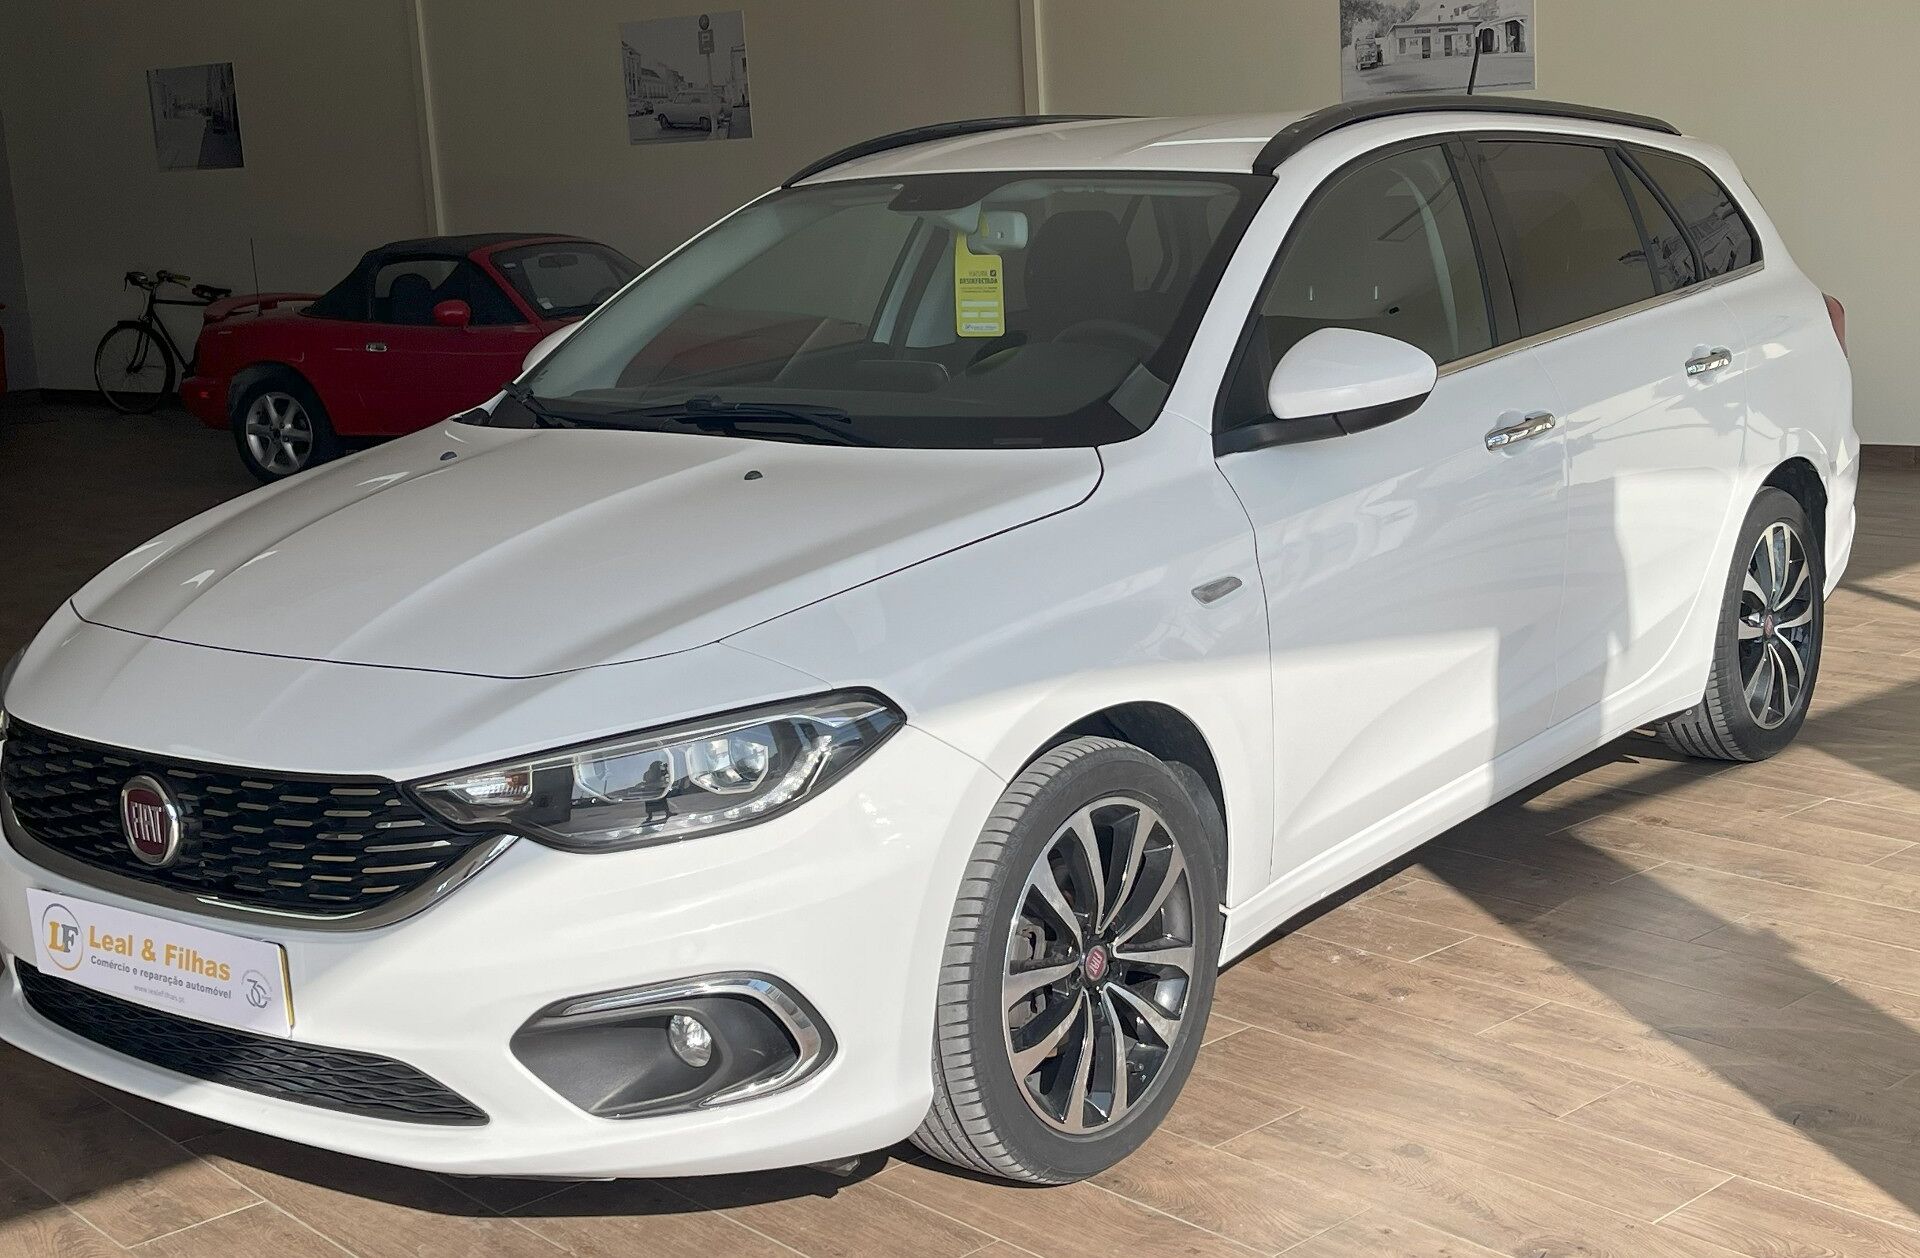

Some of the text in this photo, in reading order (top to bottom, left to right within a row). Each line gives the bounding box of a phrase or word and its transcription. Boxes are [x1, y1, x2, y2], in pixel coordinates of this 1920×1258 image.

[130, 801, 162, 844] FIAT
[89, 925, 231, 982] Leal & Filhas
[90, 955, 233, 1000] Comércio e reparação automóvel
